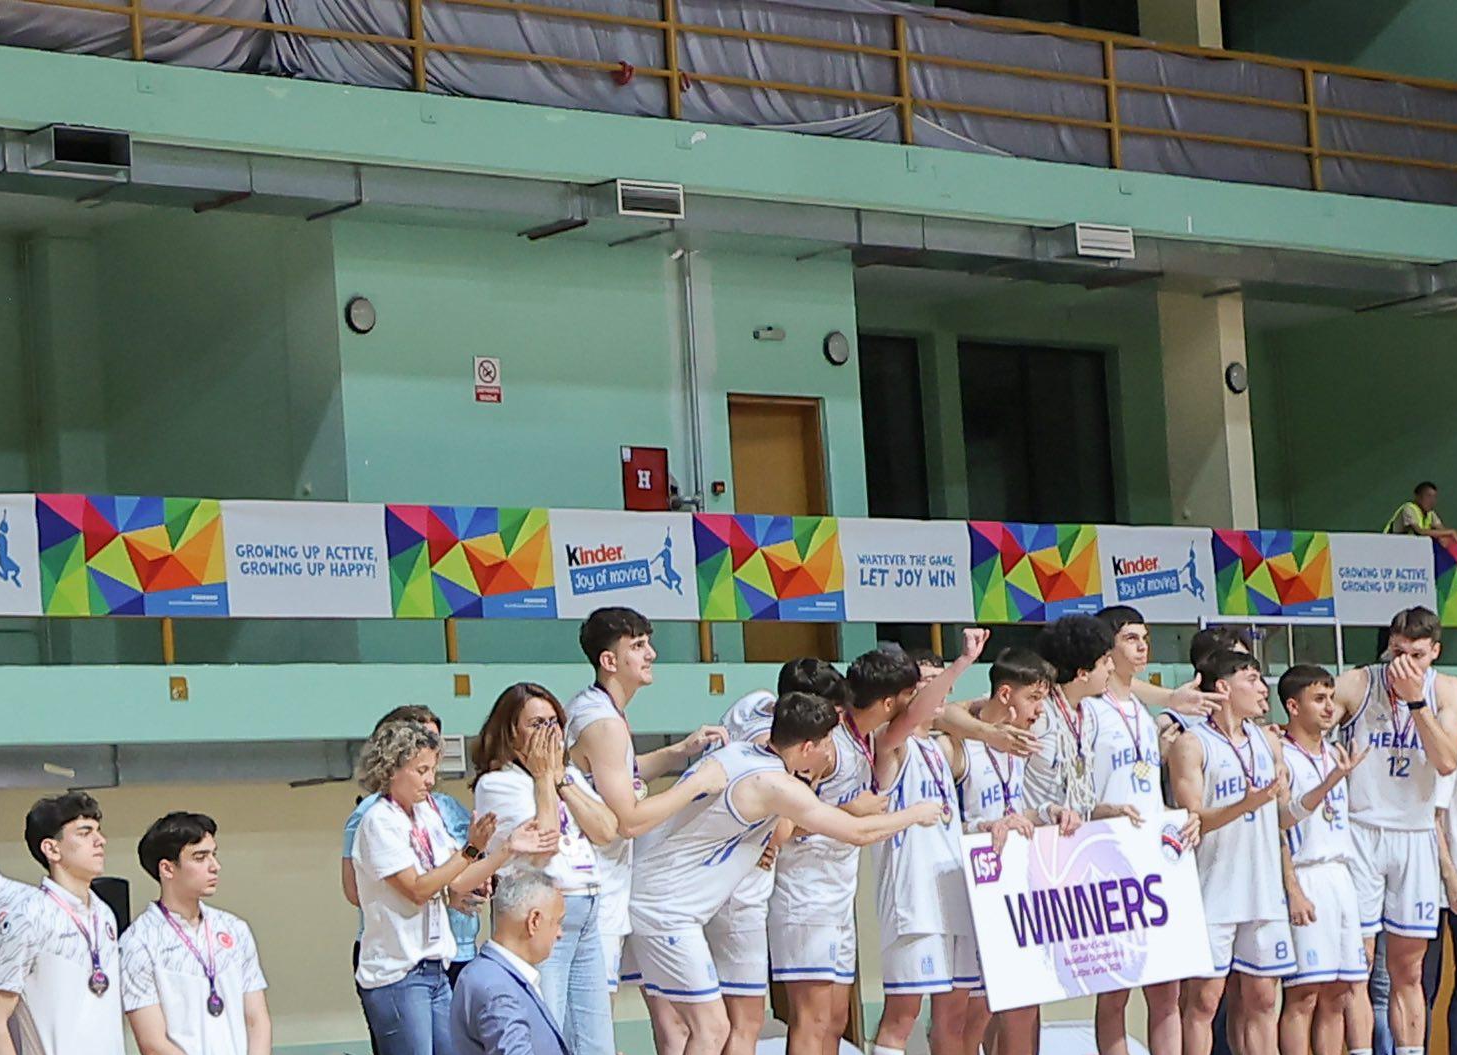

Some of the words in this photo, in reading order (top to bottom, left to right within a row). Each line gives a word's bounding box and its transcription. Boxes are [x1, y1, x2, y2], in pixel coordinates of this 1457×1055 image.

[637, 469, 652, 490] H
[235, 544, 298, 559] GROWING
[303, 545, 320, 560] UP
[326, 546, 378, 562] ACTIVE,
[858, 554, 907, 567] WHATEVER
[910, 555, 927, 567] THE
[240, 561, 303, 576] GROWING
[307, 562, 325, 578] UP
[330, 562, 377, 580] HAPPY!
[575, 572, 595, 591] Joy
[608, 566, 647, 585] moving
[860, 568, 889, 587] LET
[894, 569, 924, 588] JOY
[929, 570, 956, 588] WIN
[1387, 756, 1411, 778] 12
[974, 850, 999, 878] ISF
[1004, 874, 1169, 948] WINNERS
[1415, 901, 1435, 921] 12
[1275, 941, 1288, 960] 8
